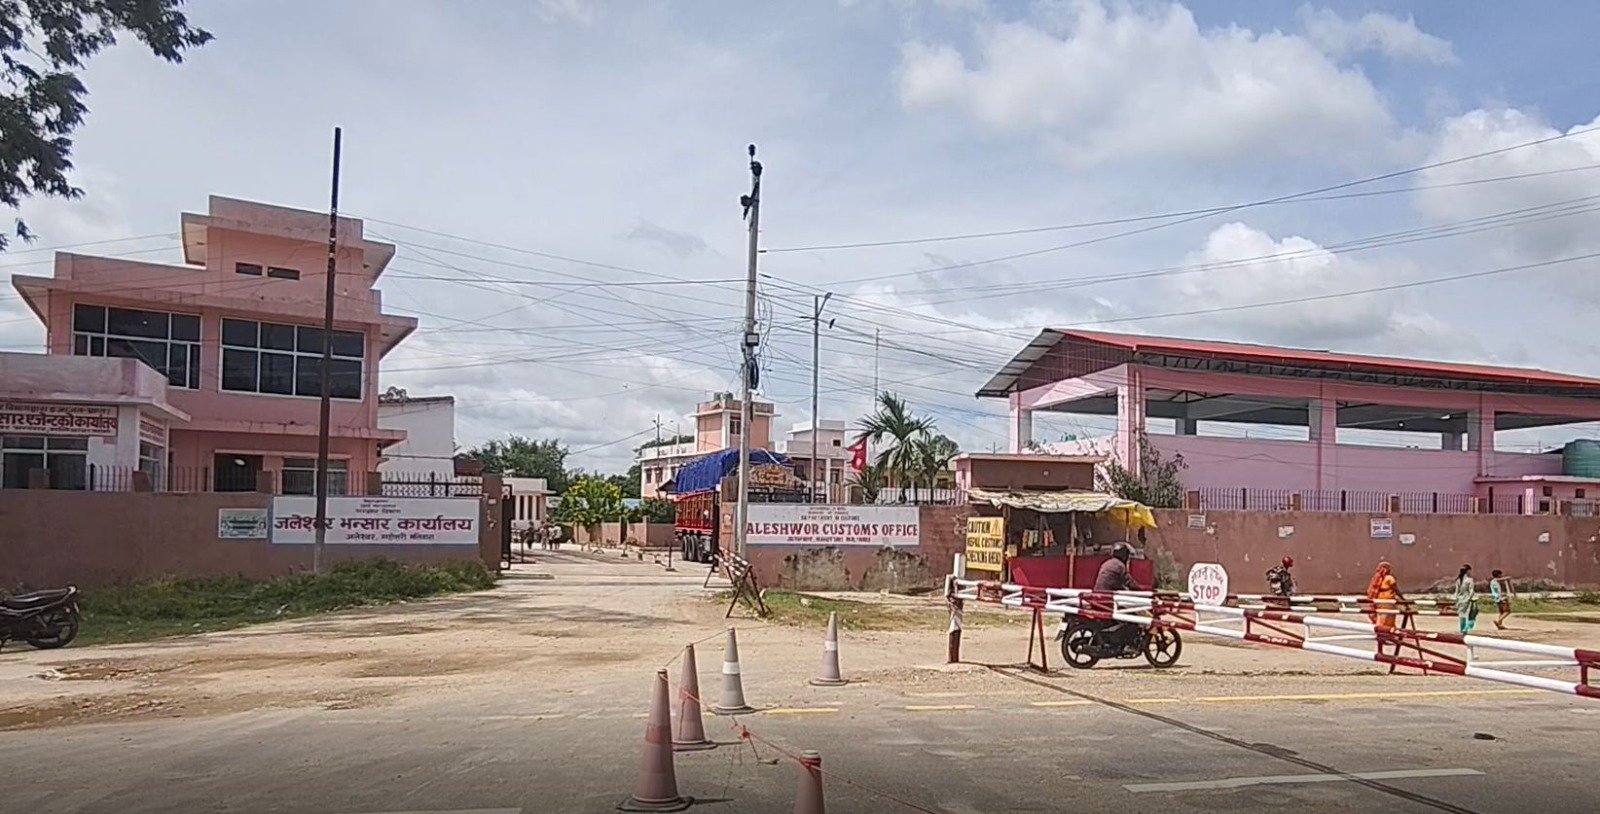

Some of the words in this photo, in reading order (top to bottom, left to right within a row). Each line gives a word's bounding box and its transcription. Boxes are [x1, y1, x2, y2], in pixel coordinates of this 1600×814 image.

[340, 517, 391, 531] भन्सार
[397, 515, 474, 531] कार्यालय
[746, 522, 819, 535] ALESHWOR
[822, 524, 879, 536] CUSTOMS
[881, 524, 918, 537] OFFICE
[1193, 585, 1220, 600] STOP
